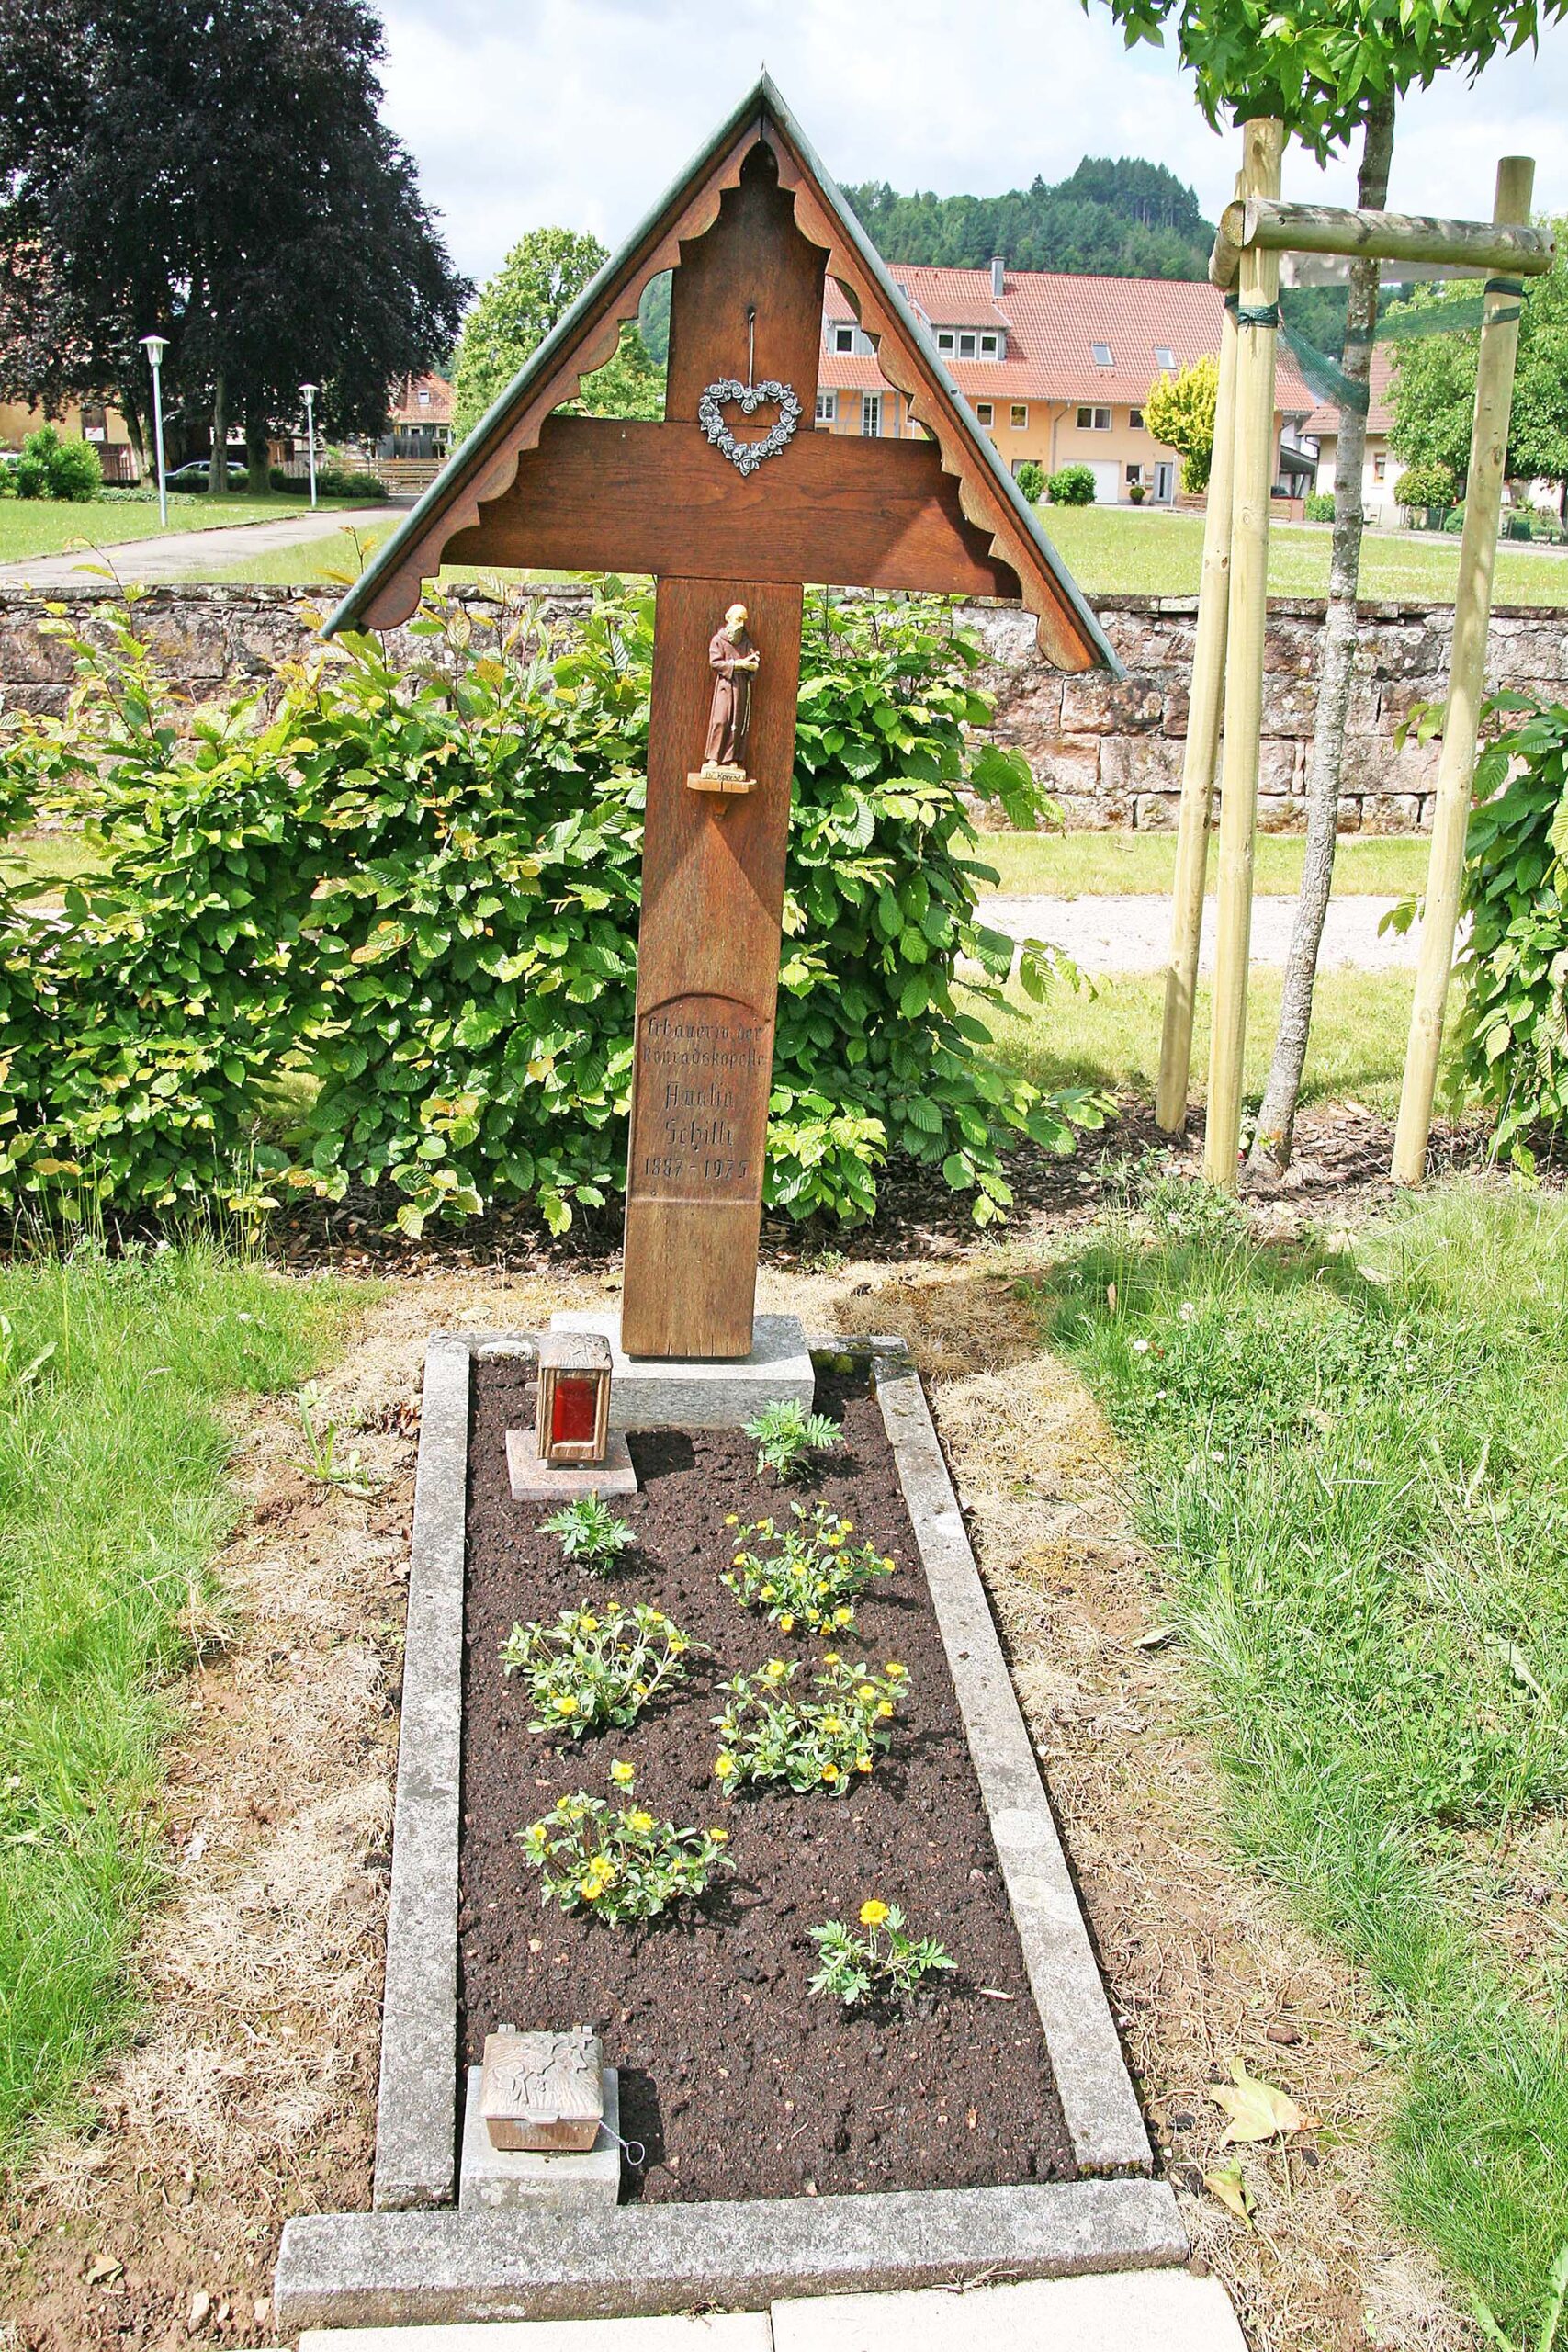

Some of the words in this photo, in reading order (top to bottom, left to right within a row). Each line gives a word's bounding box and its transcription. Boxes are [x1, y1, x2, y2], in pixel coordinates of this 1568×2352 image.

[648, 1017, 729, 1040] Erbauerin
[737, 1022, 762, 1042] der
[645, 1158, 682, 1177] 1887
[705, 1159, 749, 1180] 1975
